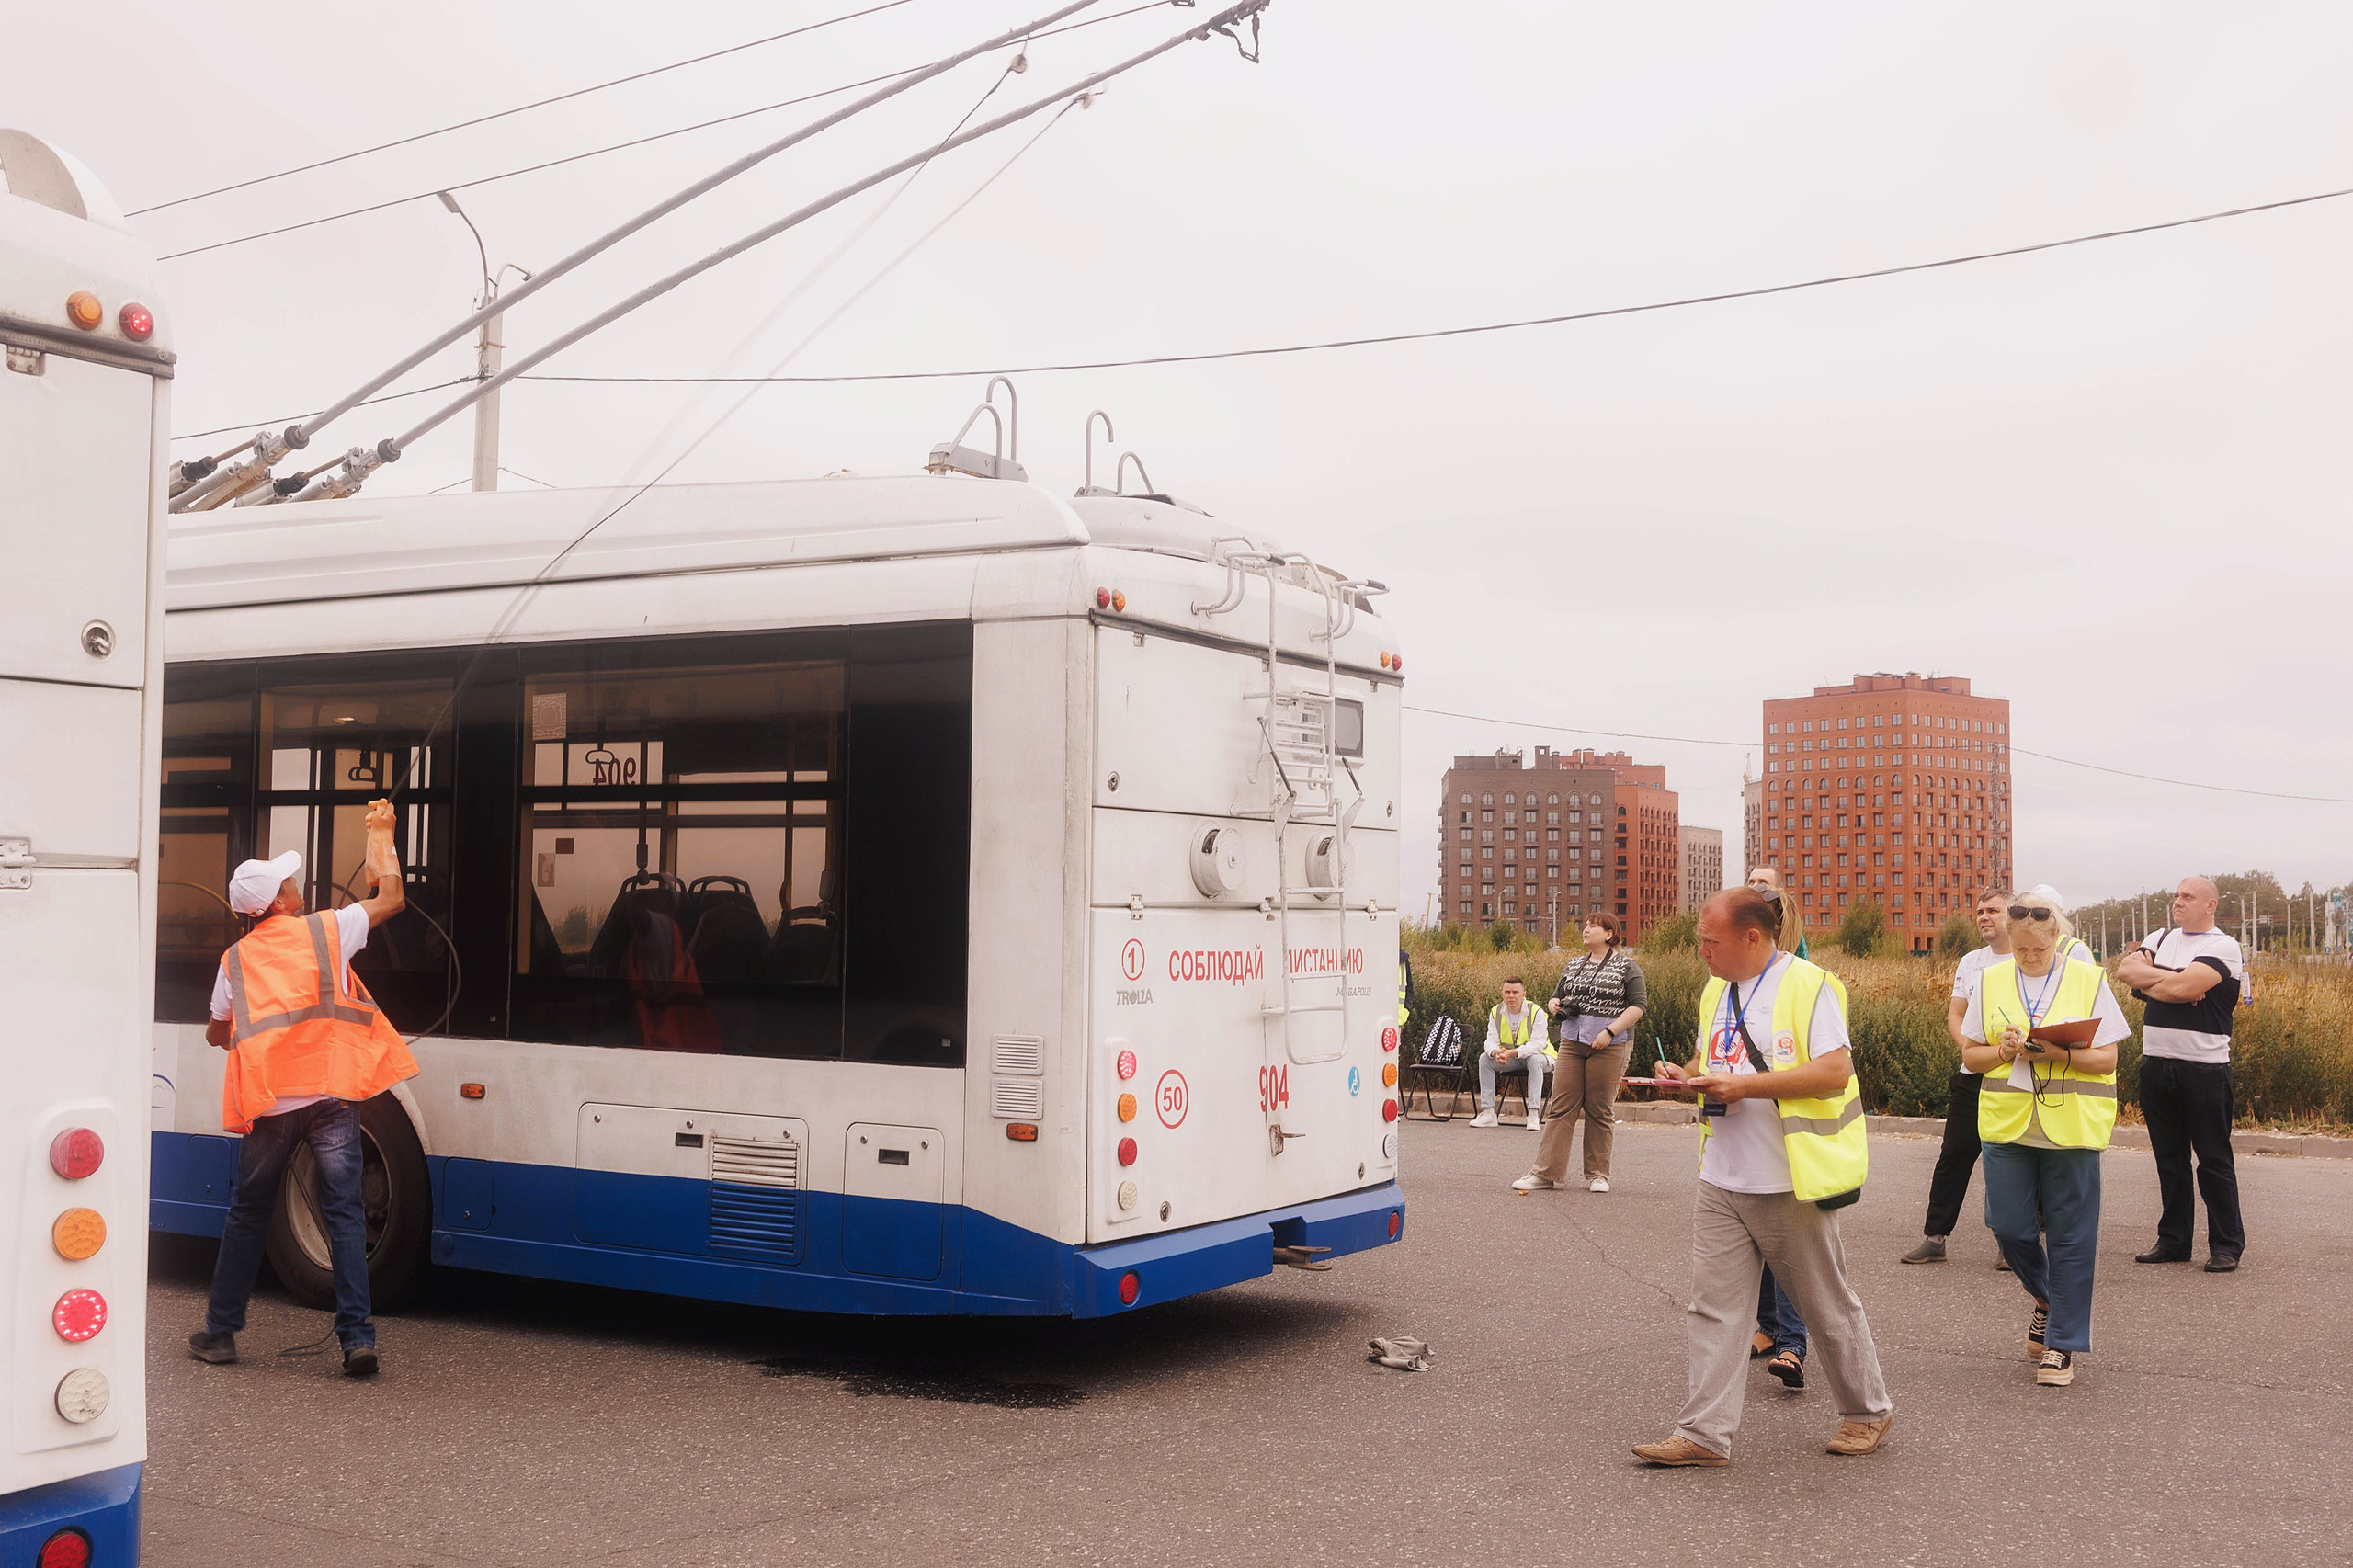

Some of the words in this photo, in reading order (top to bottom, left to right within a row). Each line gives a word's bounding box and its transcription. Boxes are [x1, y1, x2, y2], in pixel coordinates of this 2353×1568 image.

[1127, 947, 1136, 974] 1
[1168, 943, 1264, 986] СОБЛЮДАЙ
[1115, 988, 1154, 1006] TROLZA
[1336, 986, 1372, 997] MGAPOLIS
[1163, 1085, 1183, 1113] 50
[1258, 1063, 1290, 1113] 904
